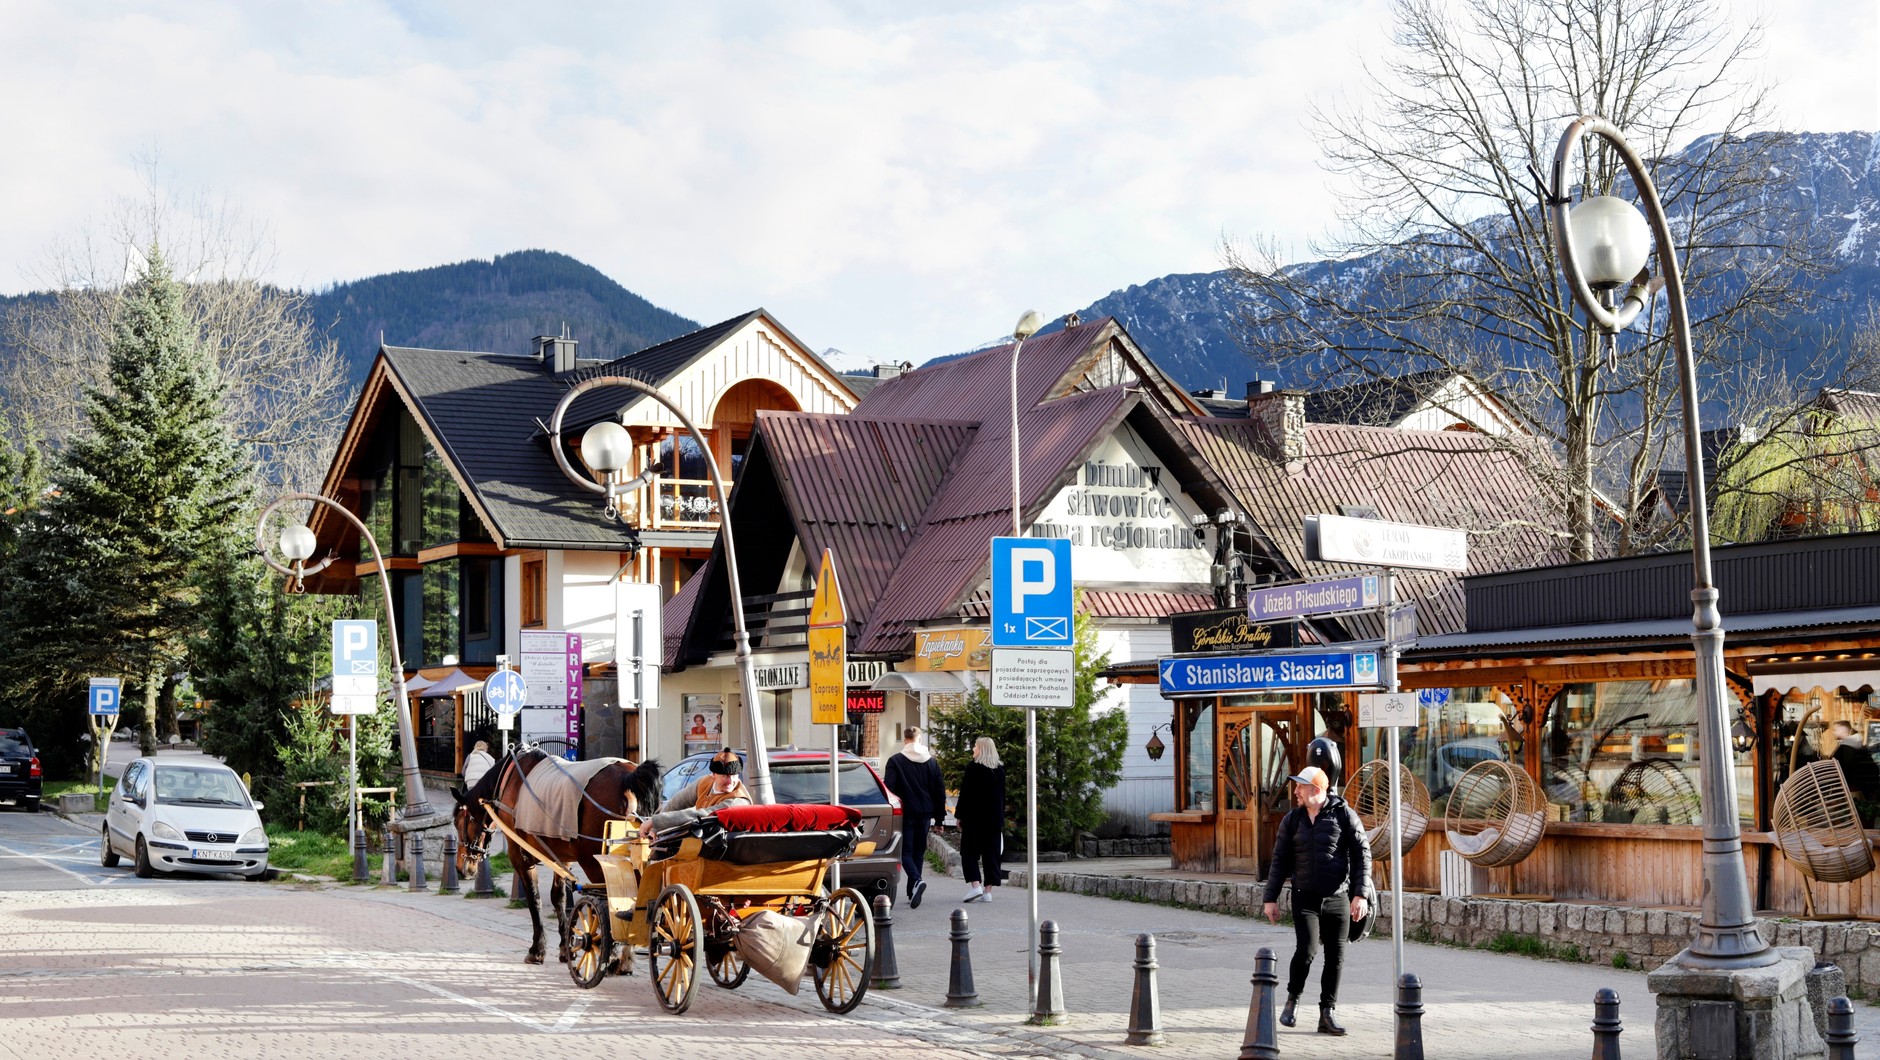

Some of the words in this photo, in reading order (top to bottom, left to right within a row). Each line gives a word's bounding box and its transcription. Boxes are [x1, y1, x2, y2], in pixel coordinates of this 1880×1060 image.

[1084, 459, 1161, 491] bimbry
[1067, 489, 1172, 519] śliwowice
[1091, 521, 1206, 551] regionalne
[1011, 547, 1056, 614] P
[1262, 592, 1293, 614] Józefa
[1295, 586, 1358, 611] Piłsudskiego
[1003, 622, 1016, 634] 1x
[1191, 627, 1234, 651] Góralskie
[1234, 624, 1272, 646] Praliny
[343, 625, 368, 660] P
[754, 666, 799, 687] EGIONALNE
[1186, 661, 1275, 686] Stanisława
[1279, 660, 1345, 682] Staszica
[96, 689, 114, 712] P
